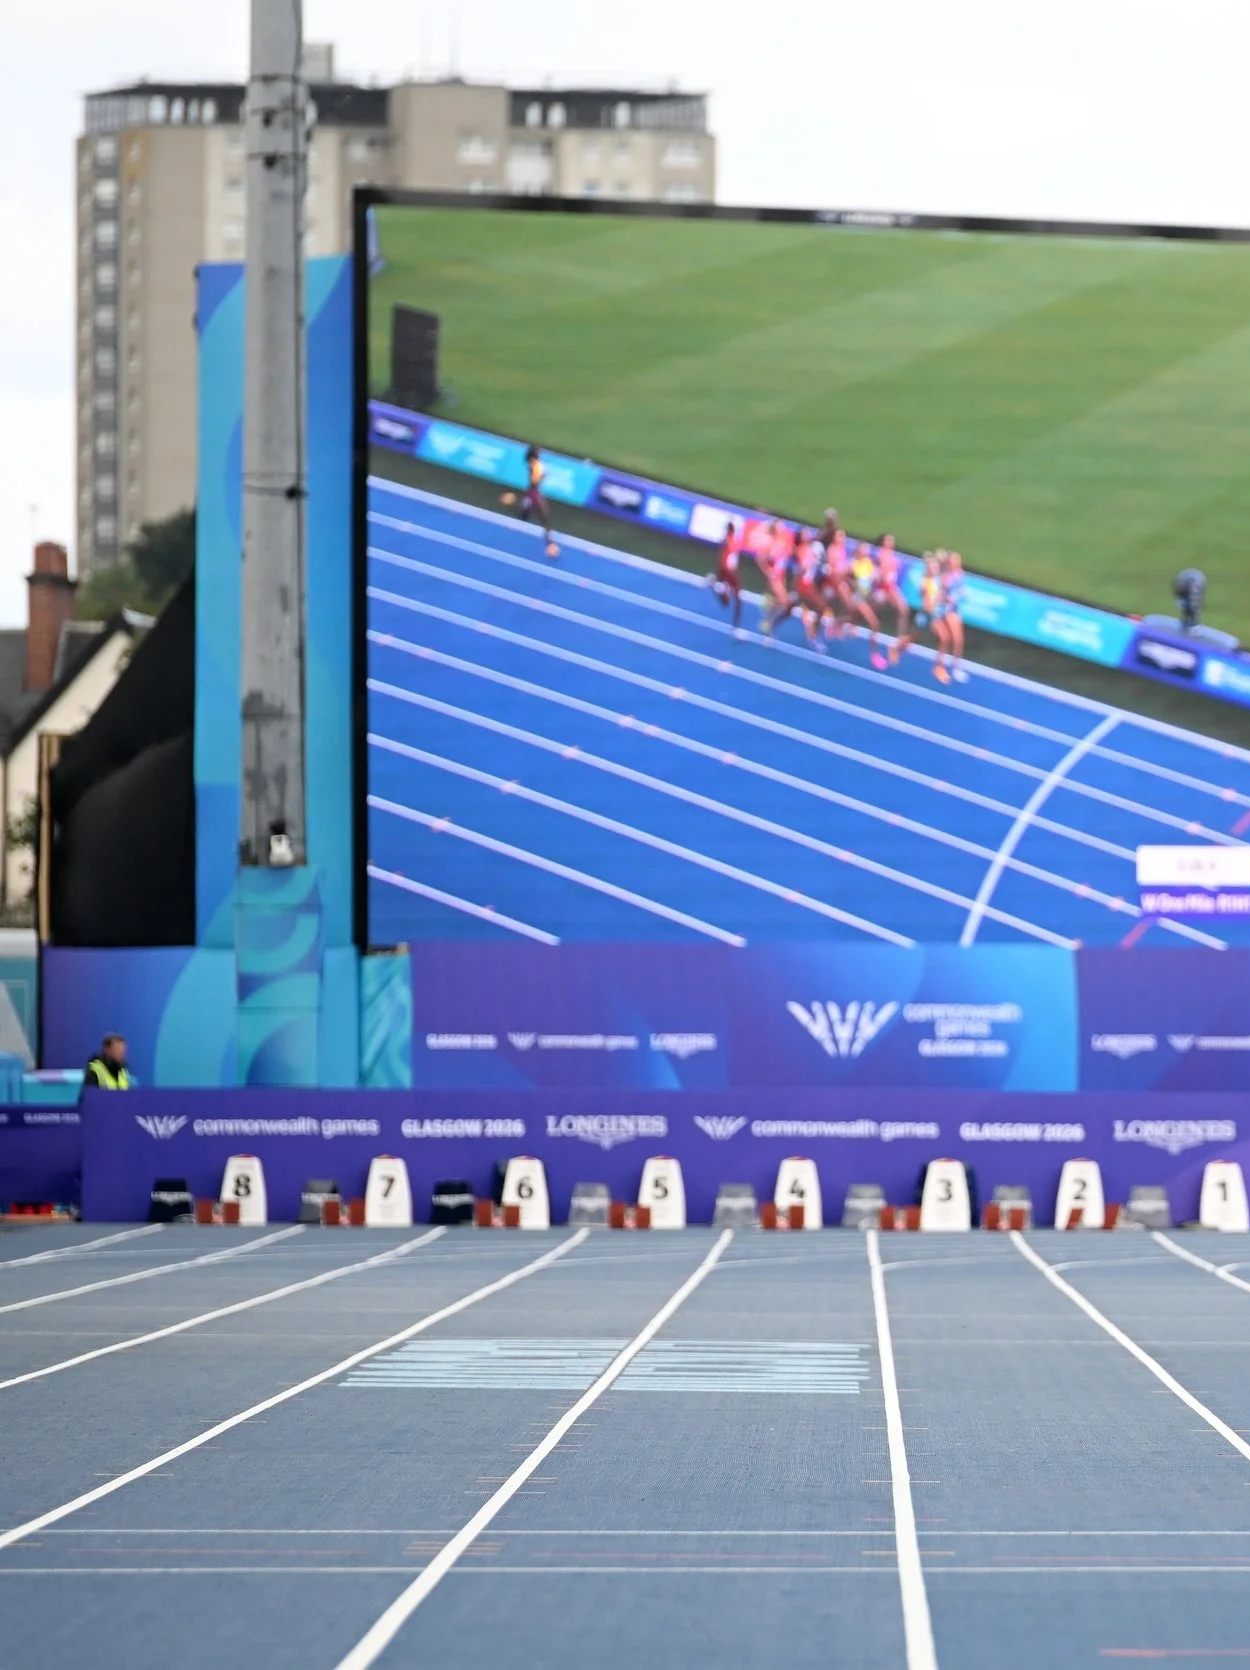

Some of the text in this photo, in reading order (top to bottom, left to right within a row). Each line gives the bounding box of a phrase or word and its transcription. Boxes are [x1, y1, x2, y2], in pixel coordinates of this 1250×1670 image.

[193, 1116, 380, 1140] commonwealth games
[401, 1118, 526, 1138] GLASGOW 2026
[546, 1114, 668, 1138] LONGINES
[751, 1119, 940, 1142] commonwealth games
[960, 1122, 1086, 1141] GLASGOW 2026
[1113, 1119, 1237, 1142] LONGINES
[233, 1175, 251, 1198] 8
[381, 1175, 396, 1199] 7
[517, 1177, 534, 1199] 6
[653, 1177, 669, 1199] 5
[789, 1178, 805, 1199] 4
[938, 1179, 954, 1201] 3
[1072, 1179, 1087, 1200] 2
[1215, 1180, 1228, 1202] 1
